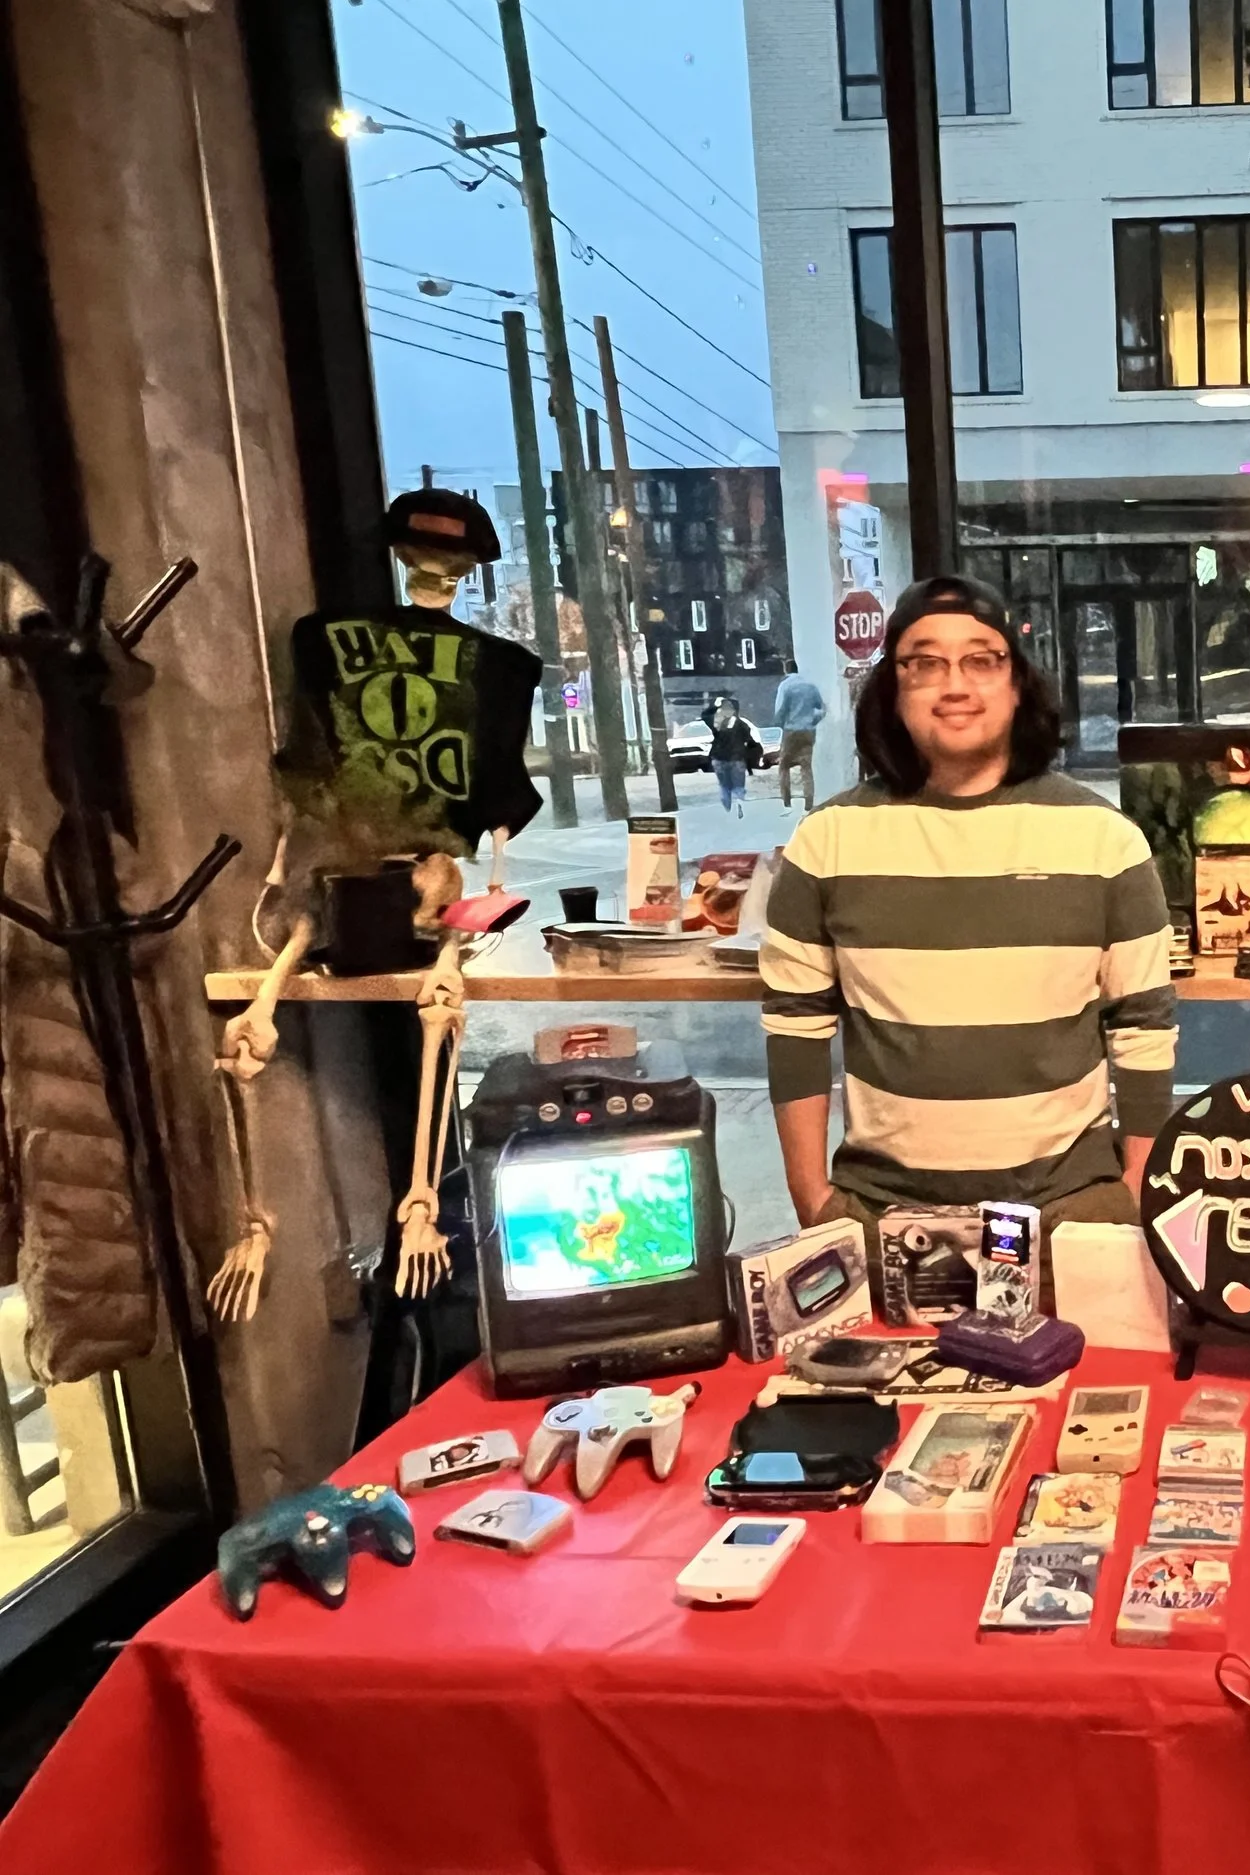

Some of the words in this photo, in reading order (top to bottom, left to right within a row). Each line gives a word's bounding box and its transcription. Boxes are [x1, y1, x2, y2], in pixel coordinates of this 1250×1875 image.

[838, 611, 883, 641] STOP
[880, 1232, 904, 1269] BOY
[747, 1269, 767, 1305] BOY
